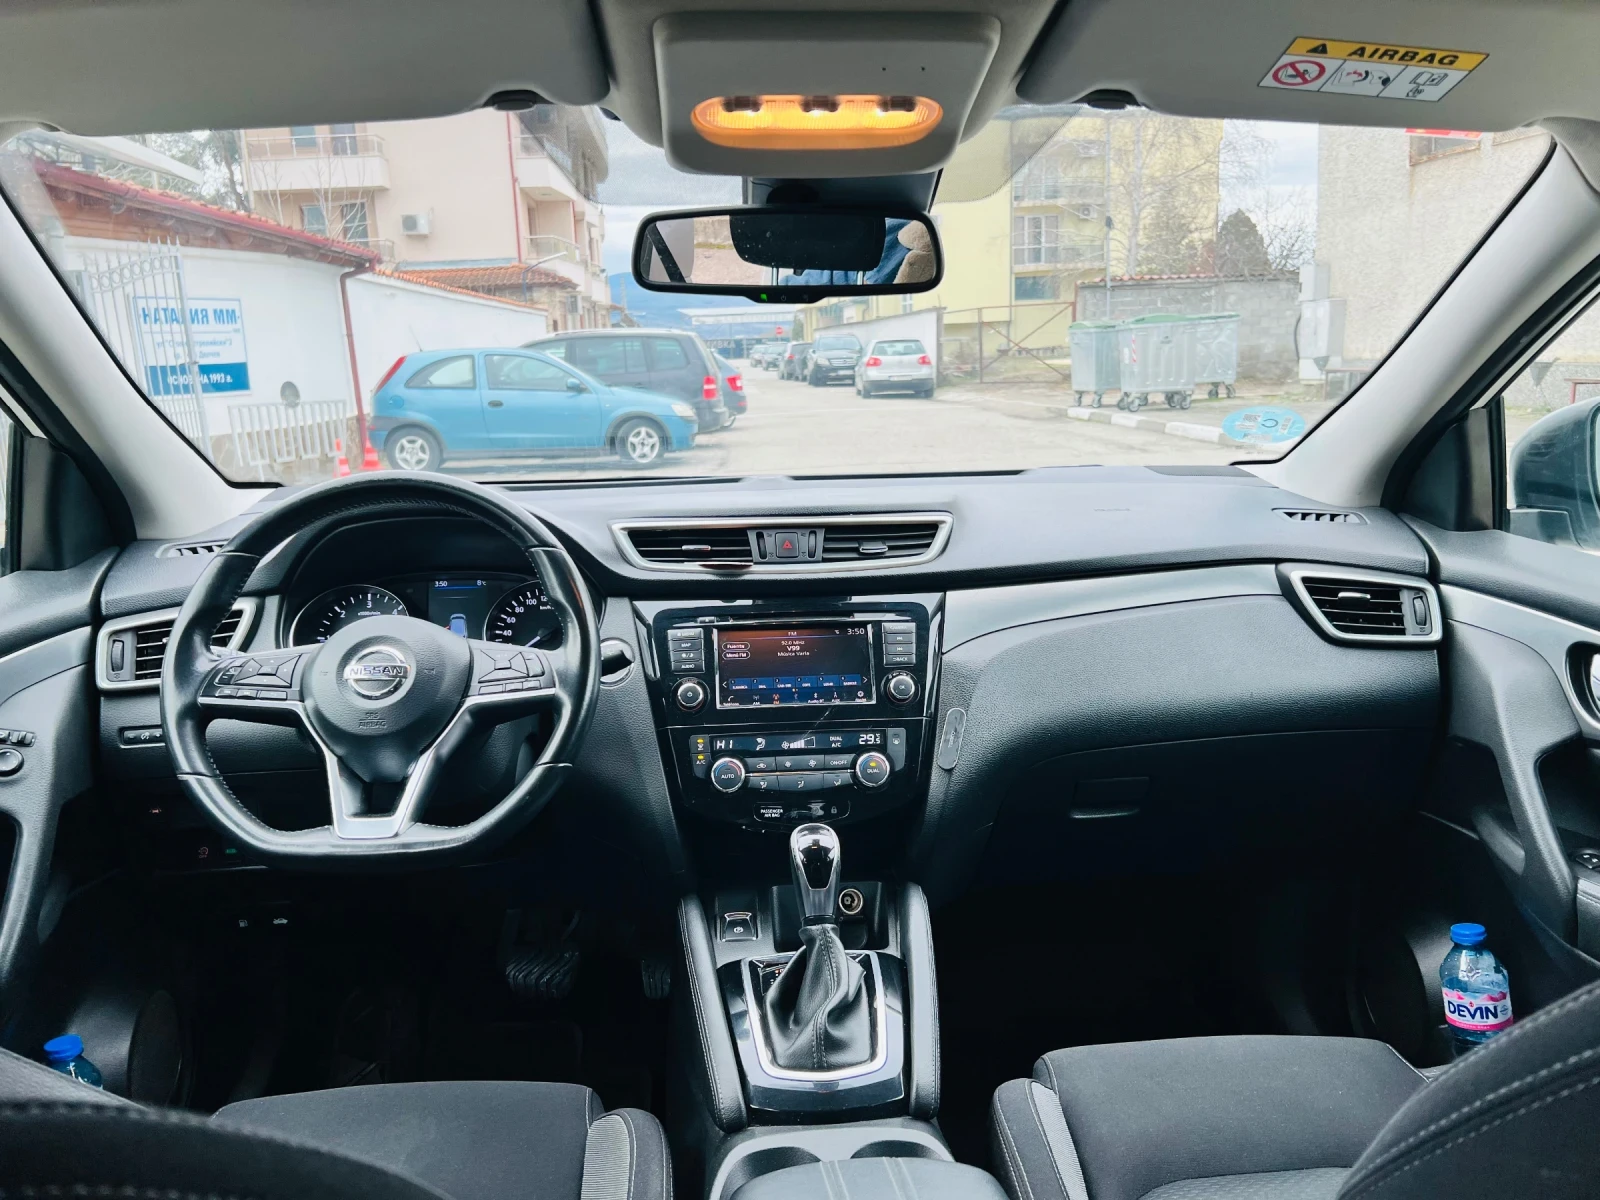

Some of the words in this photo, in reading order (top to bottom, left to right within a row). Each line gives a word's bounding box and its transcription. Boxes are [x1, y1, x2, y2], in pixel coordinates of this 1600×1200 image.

[1347, 46, 1460, 66] AIRBAG
[141, 307, 209, 324] НАТАИЯ
[210, 372, 224, 384] 1993
[349, 666, 404, 676] NISSAN
[1448, 1000, 1498, 1020] DEVIN
